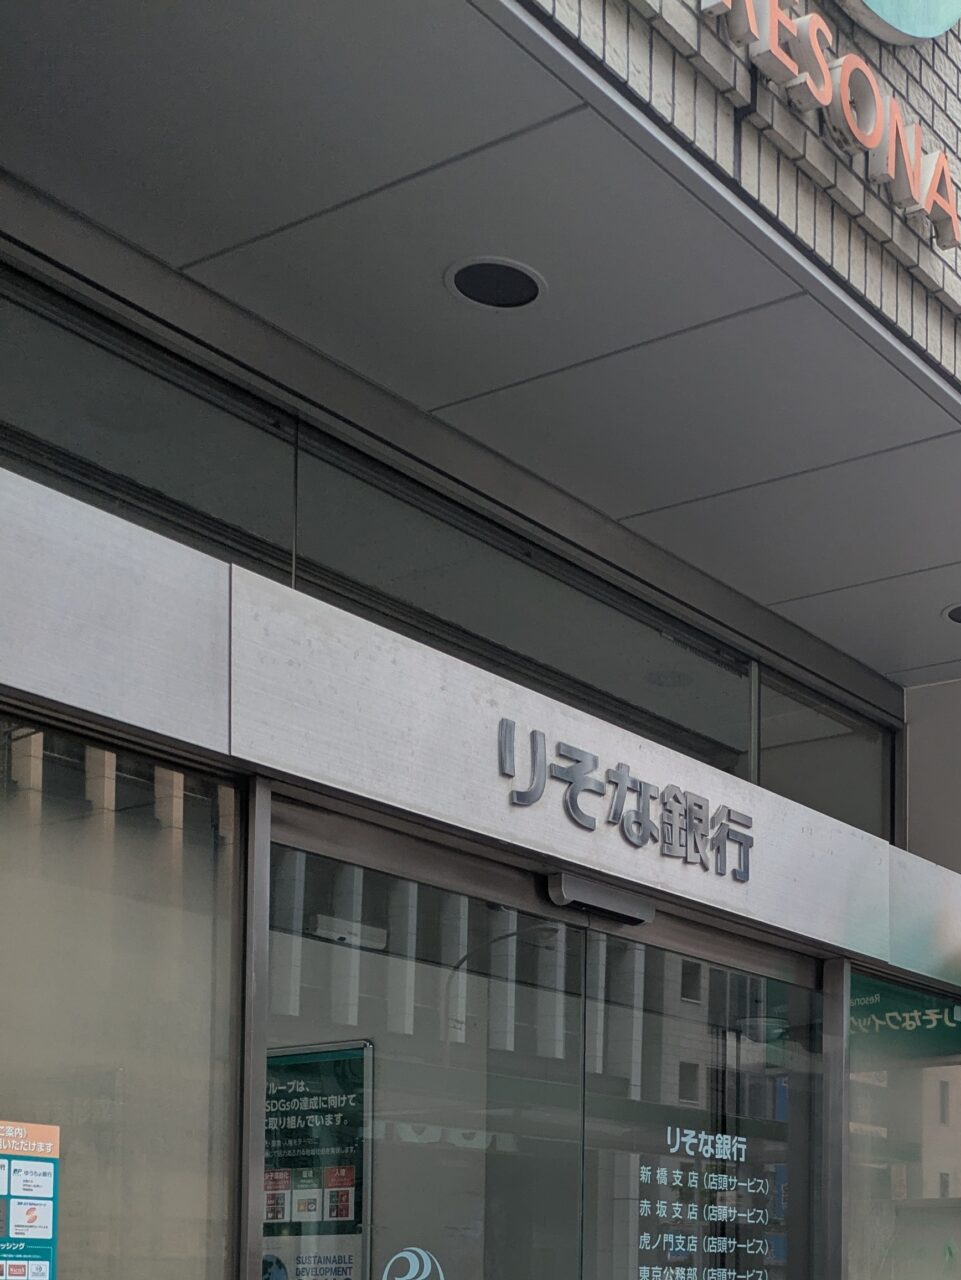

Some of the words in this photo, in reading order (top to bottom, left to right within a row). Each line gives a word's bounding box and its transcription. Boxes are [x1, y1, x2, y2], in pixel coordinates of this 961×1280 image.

[498, 718, 754, 882] りそな銀行
[667, 1126, 747, 1161] りそな銀行
[296, 1254, 353, 1265] SUSTAINABLE
[296, 1267, 353, 1277] DEVELOPMENT
